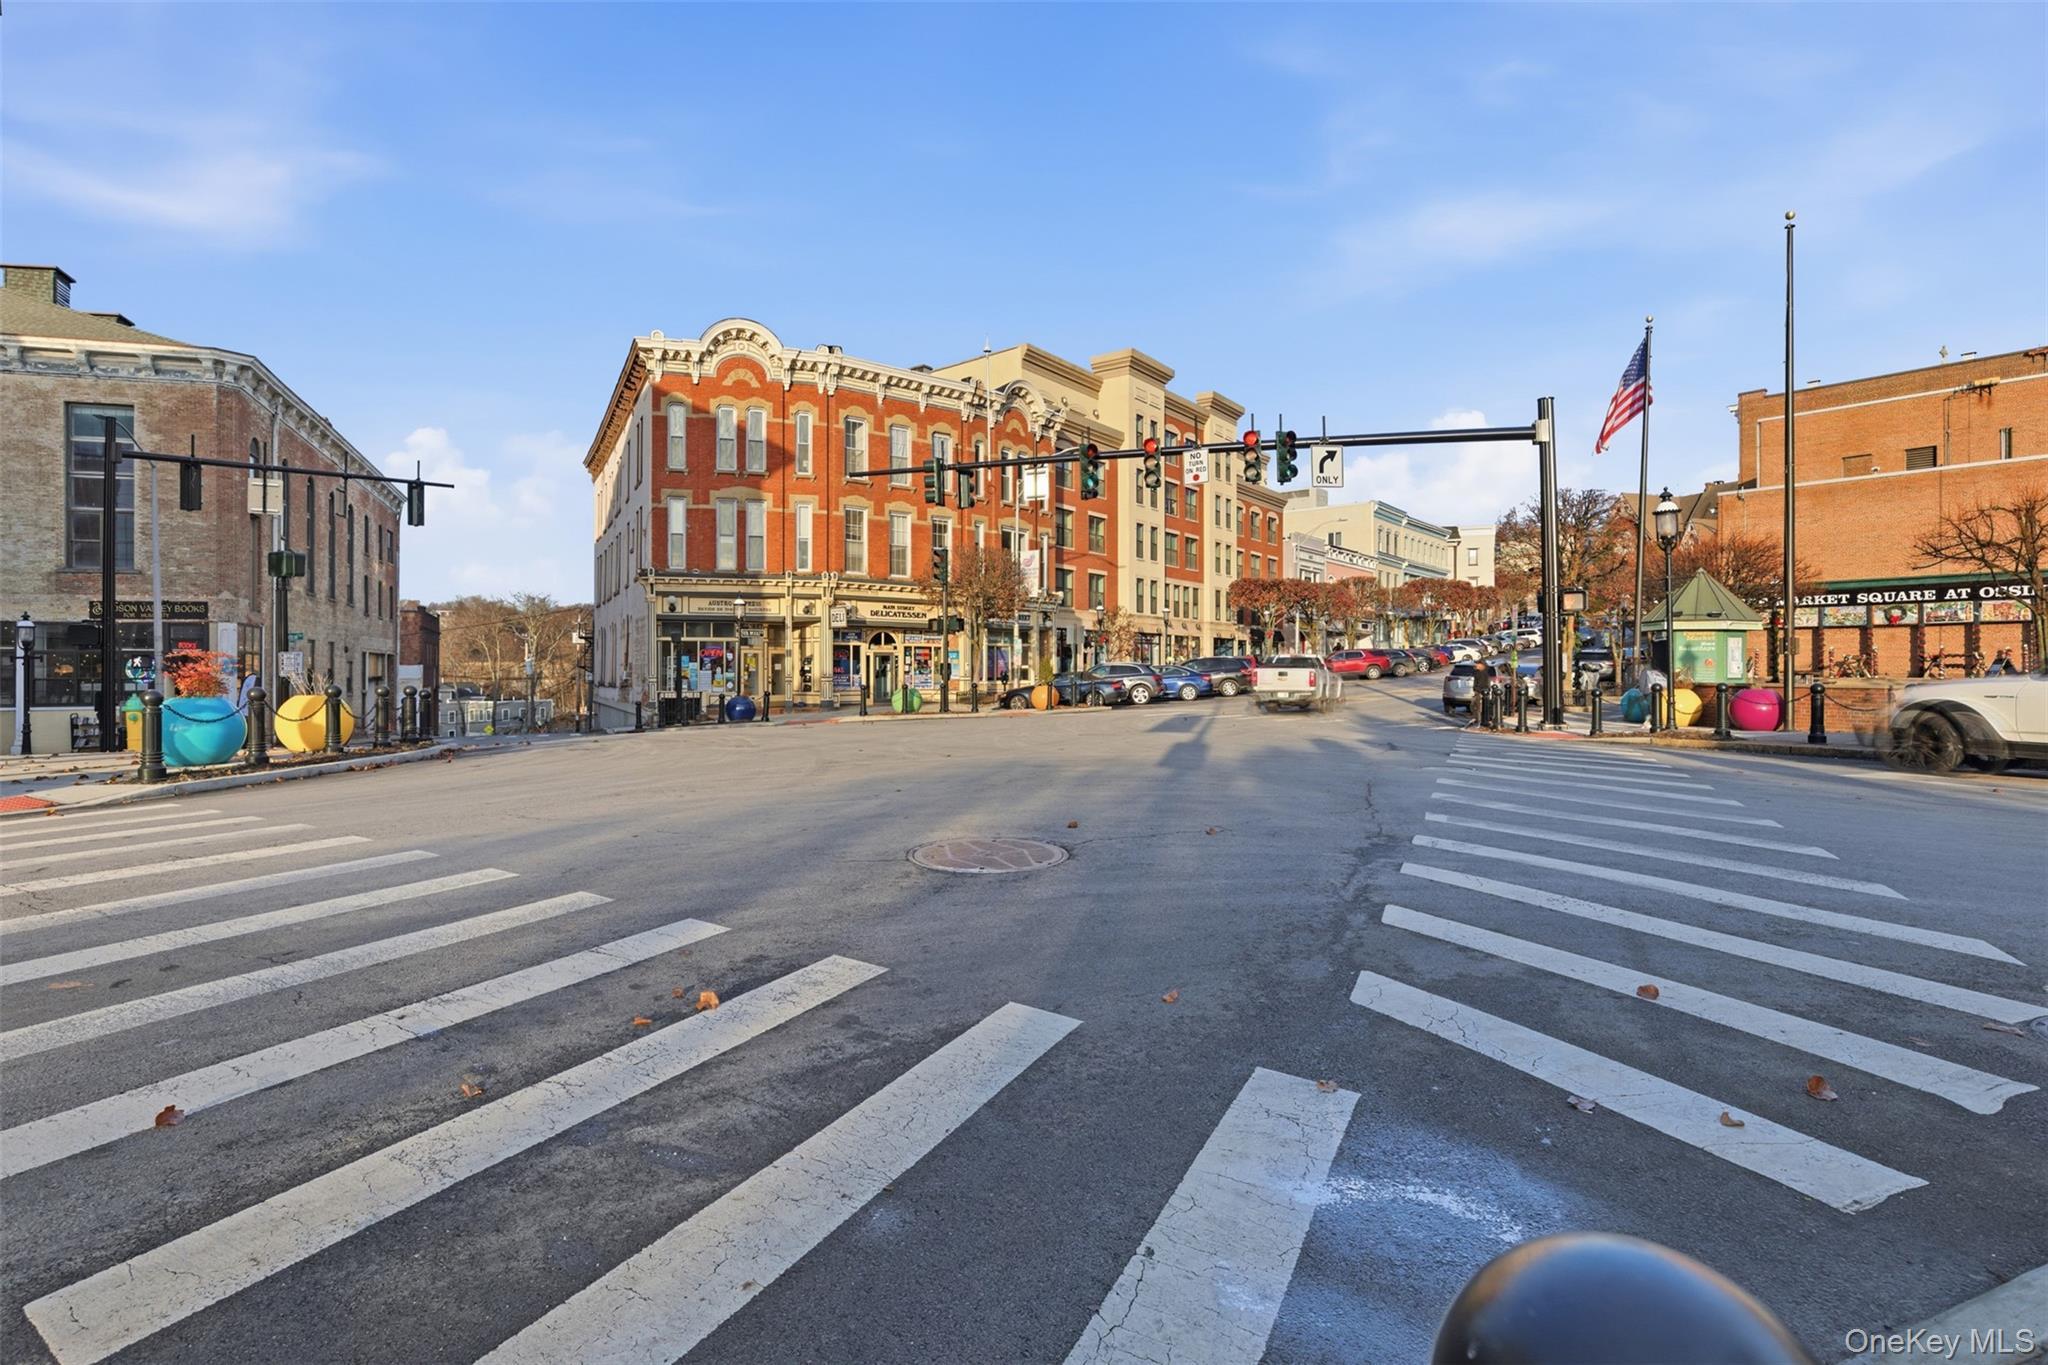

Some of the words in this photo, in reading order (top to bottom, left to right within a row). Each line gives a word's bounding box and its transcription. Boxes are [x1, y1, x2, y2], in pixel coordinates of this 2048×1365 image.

[1190, 452, 1202, 460] NO
[1316, 475, 1339, 484] ONLY
[1857, 589, 1936, 604] SQUARE
[1945, 587, 1971, 600] AT
[139, 604, 172, 613] VAEY
[174, 604, 206, 613] BOOKS
[832, 613, 845, 623] DELI
[870, 610, 927, 619] DELICATESSEN
[700, 649, 724, 657] OPEN
